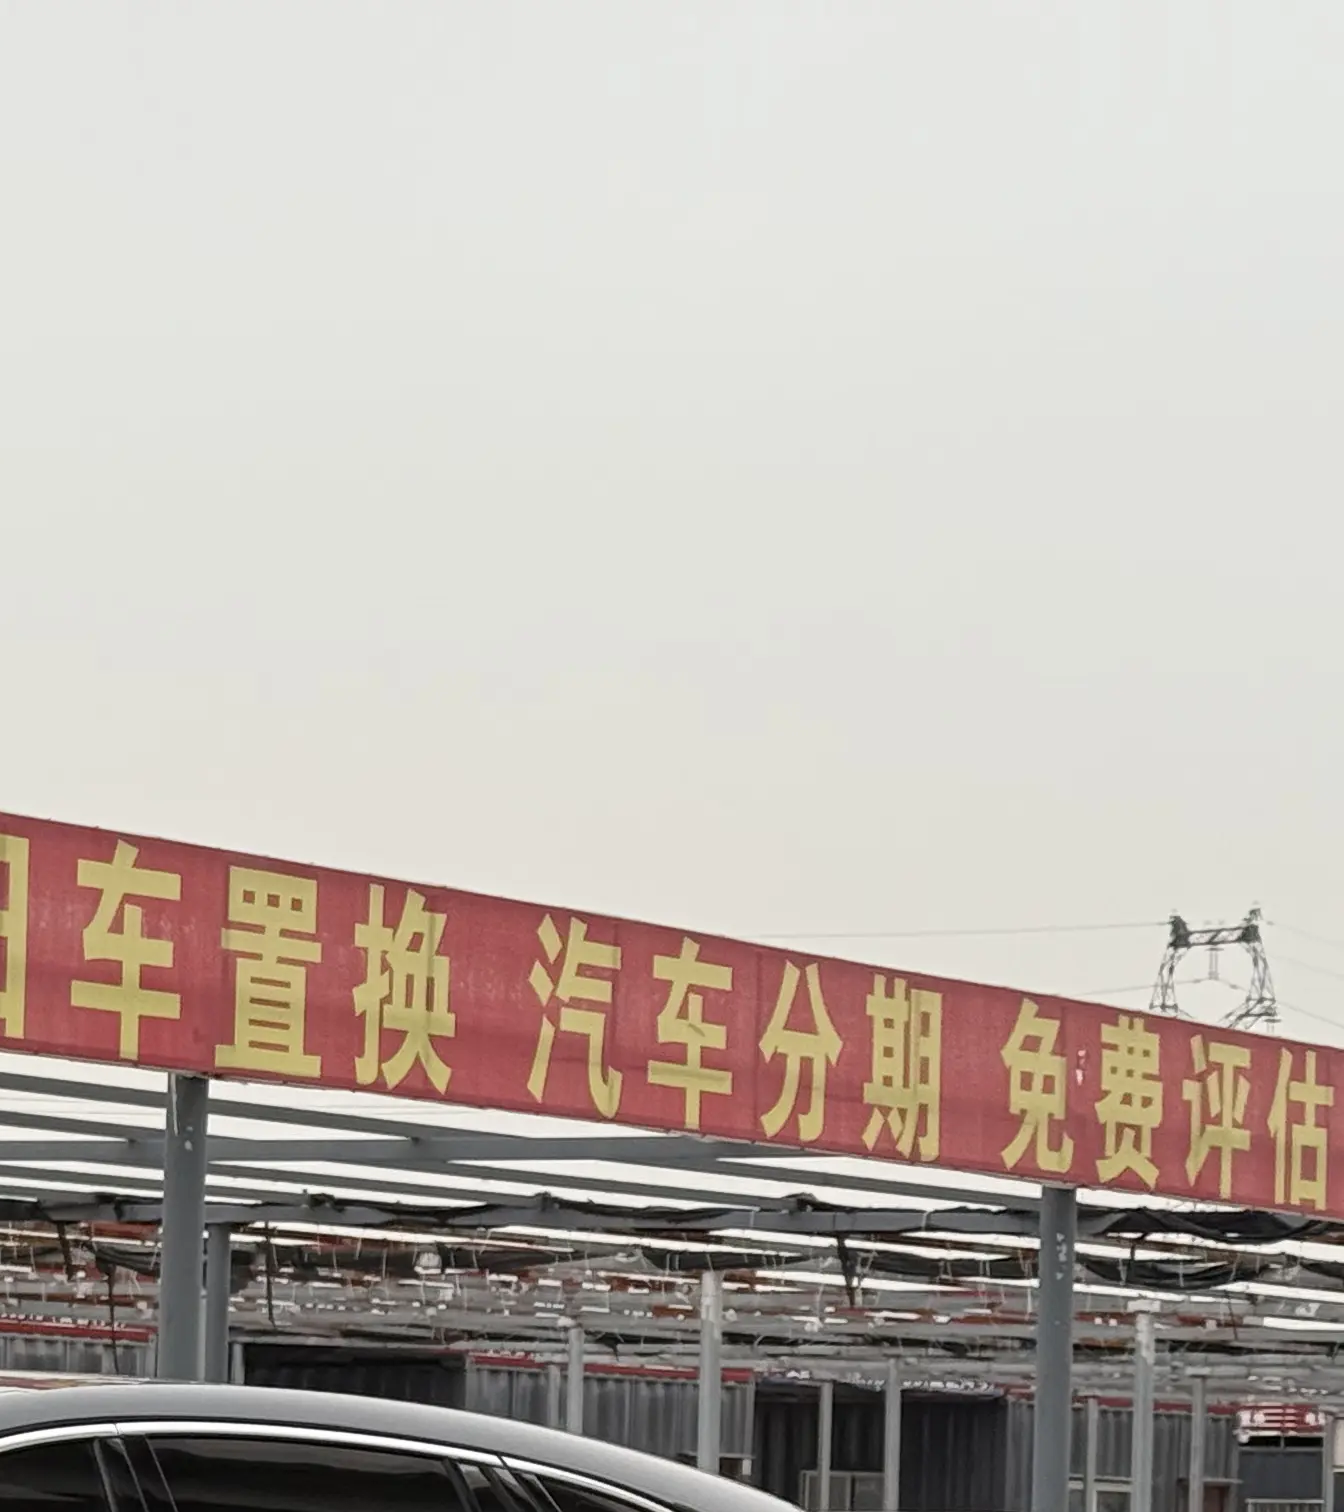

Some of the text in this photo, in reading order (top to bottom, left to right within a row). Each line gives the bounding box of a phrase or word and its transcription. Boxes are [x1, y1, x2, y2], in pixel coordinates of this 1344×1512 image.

[528, 913, 943, 1162] 汽车分期
[1001, 998, 1334, 1211] 免费评估
